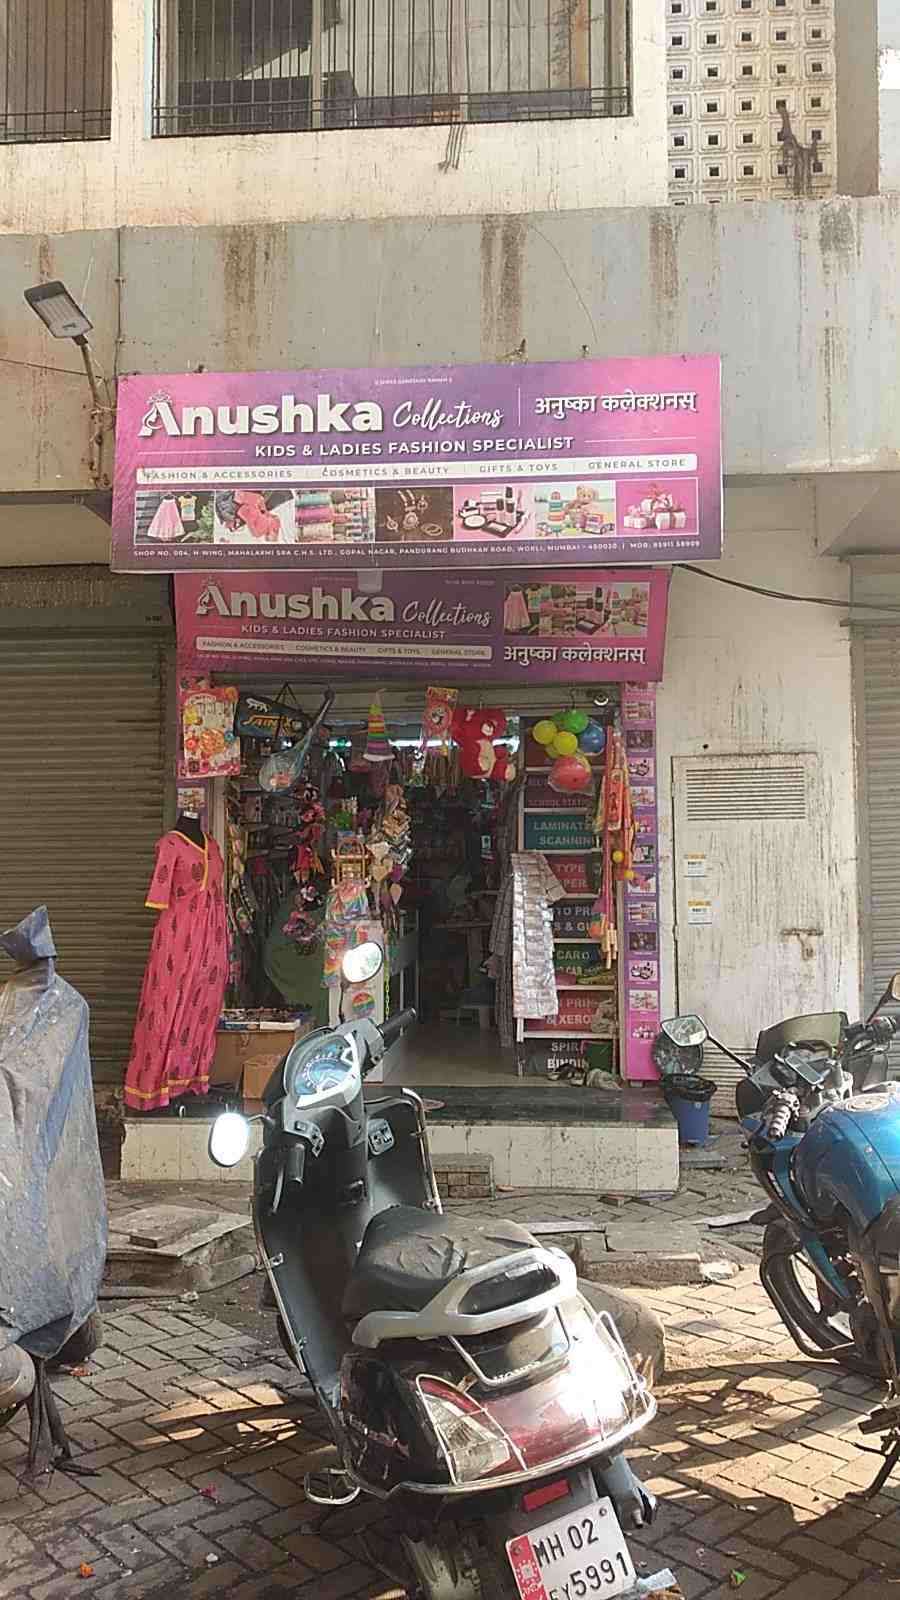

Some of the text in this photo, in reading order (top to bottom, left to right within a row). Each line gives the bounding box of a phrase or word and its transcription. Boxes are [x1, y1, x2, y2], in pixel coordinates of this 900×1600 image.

[535, 388, 698, 419] अनुष्का कलेक्शनस्
[138, 391, 505, 436] Anushka Collections
[255, 436, 575, 457] KIDS & LADIES FASHION SPECIALIST
[321, 467, 388, 477] COSMETICS
[404, 466, 449, 476] BEAUTY
[479, 464, 513, 474] GIFTS
[529, 462, 559, 472] TOYS
[587, 458, 687, 470] GENERAL STORE
[145, 471, 198, 480] FASHION
[214, 470, 293, 479] ACCESSORIES
[195, 580, 493, 628] Anushka Collections
[240, 624, 447, 639] KIDS & LADIES FASHION SPECIALIST
[503, 645, 559, 666] अनुष्का
[561, 642, 646, 664] कलेक्शनस्
[540, 835, 592, 845] SCANNIN
[559, 1014, 592, 1025] XERO
[532, 1518, 599, 1568] MH 02
[569, 1552, 629, 1596] 5991
